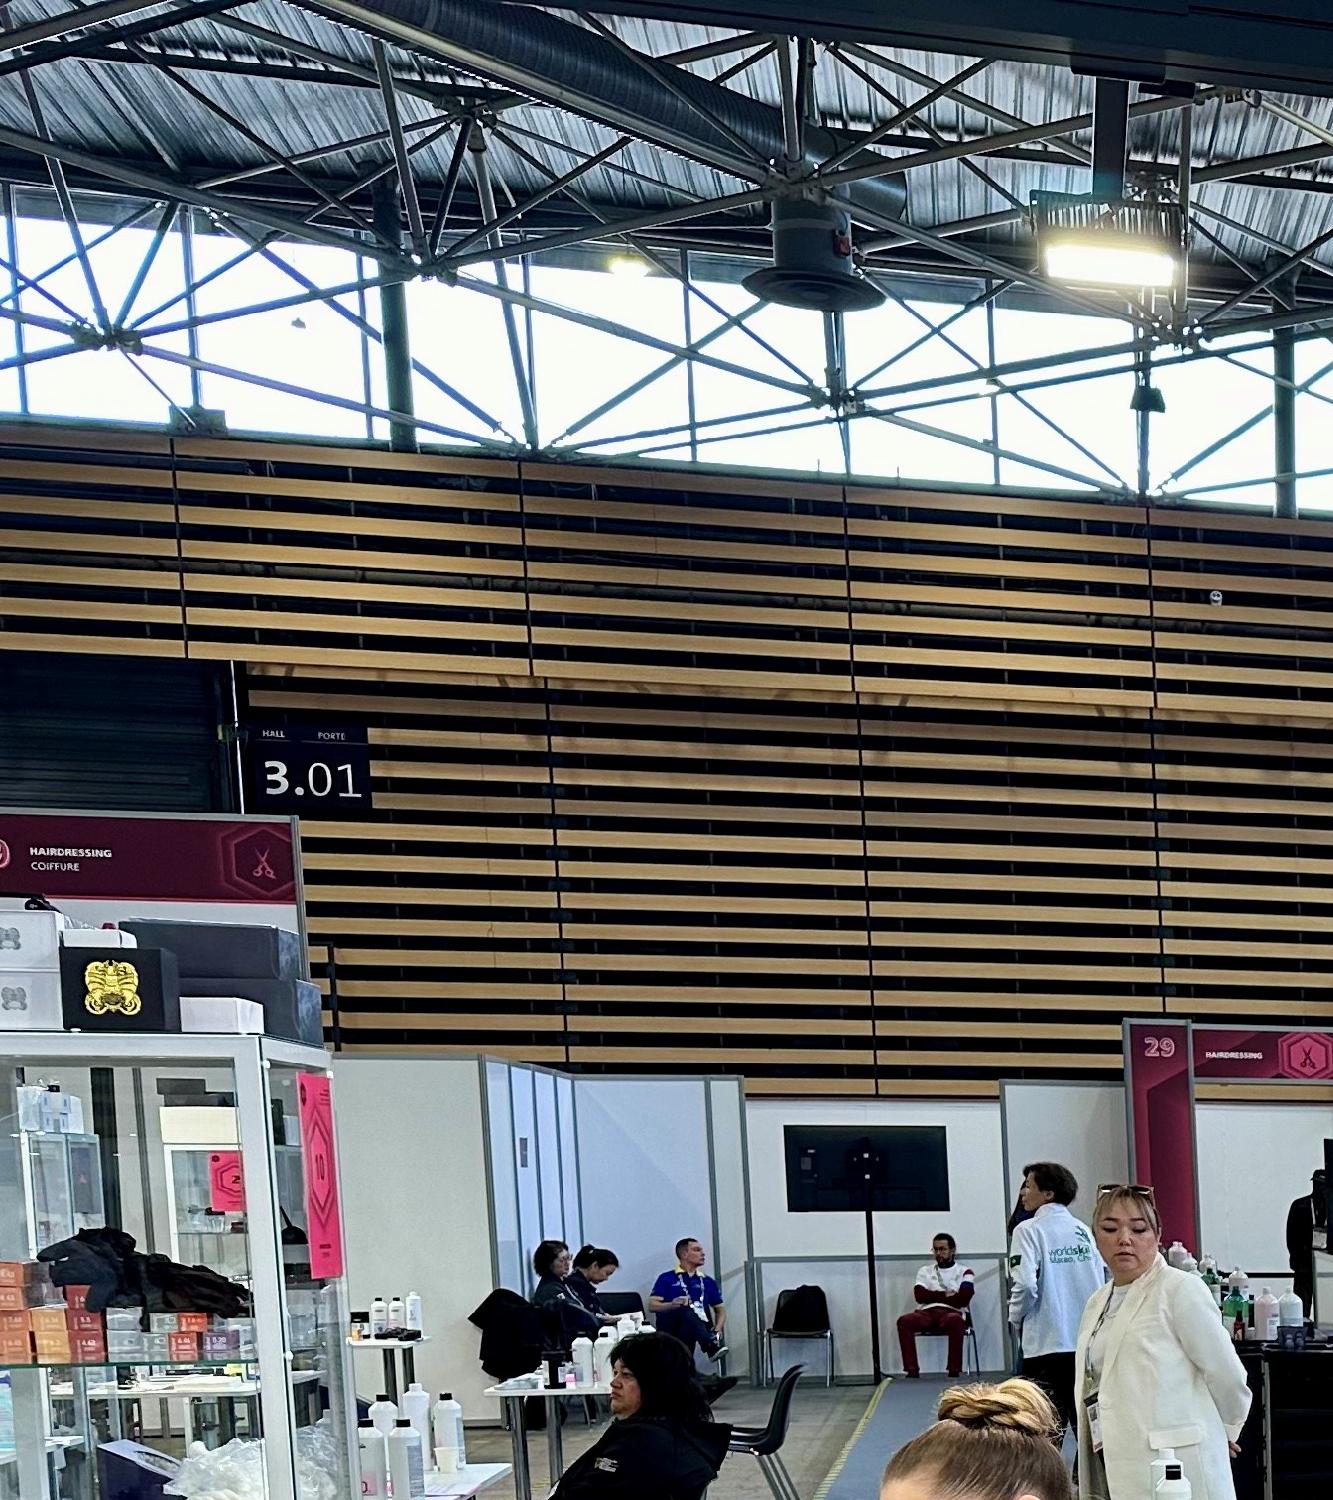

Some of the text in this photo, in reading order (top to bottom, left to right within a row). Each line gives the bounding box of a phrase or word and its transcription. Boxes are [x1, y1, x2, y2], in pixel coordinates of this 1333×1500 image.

[262, 729, 286, 738] HALL
[264, 760, 362, 798] 3.01
[29, 847, 112, 858] HAIRDRESSING
[30, 861, 80, 872] COIFFURE
[1144, 1037, 1175, 1058] 29
[1205, 1051, 1263, 1060] HAIRDRESSING
